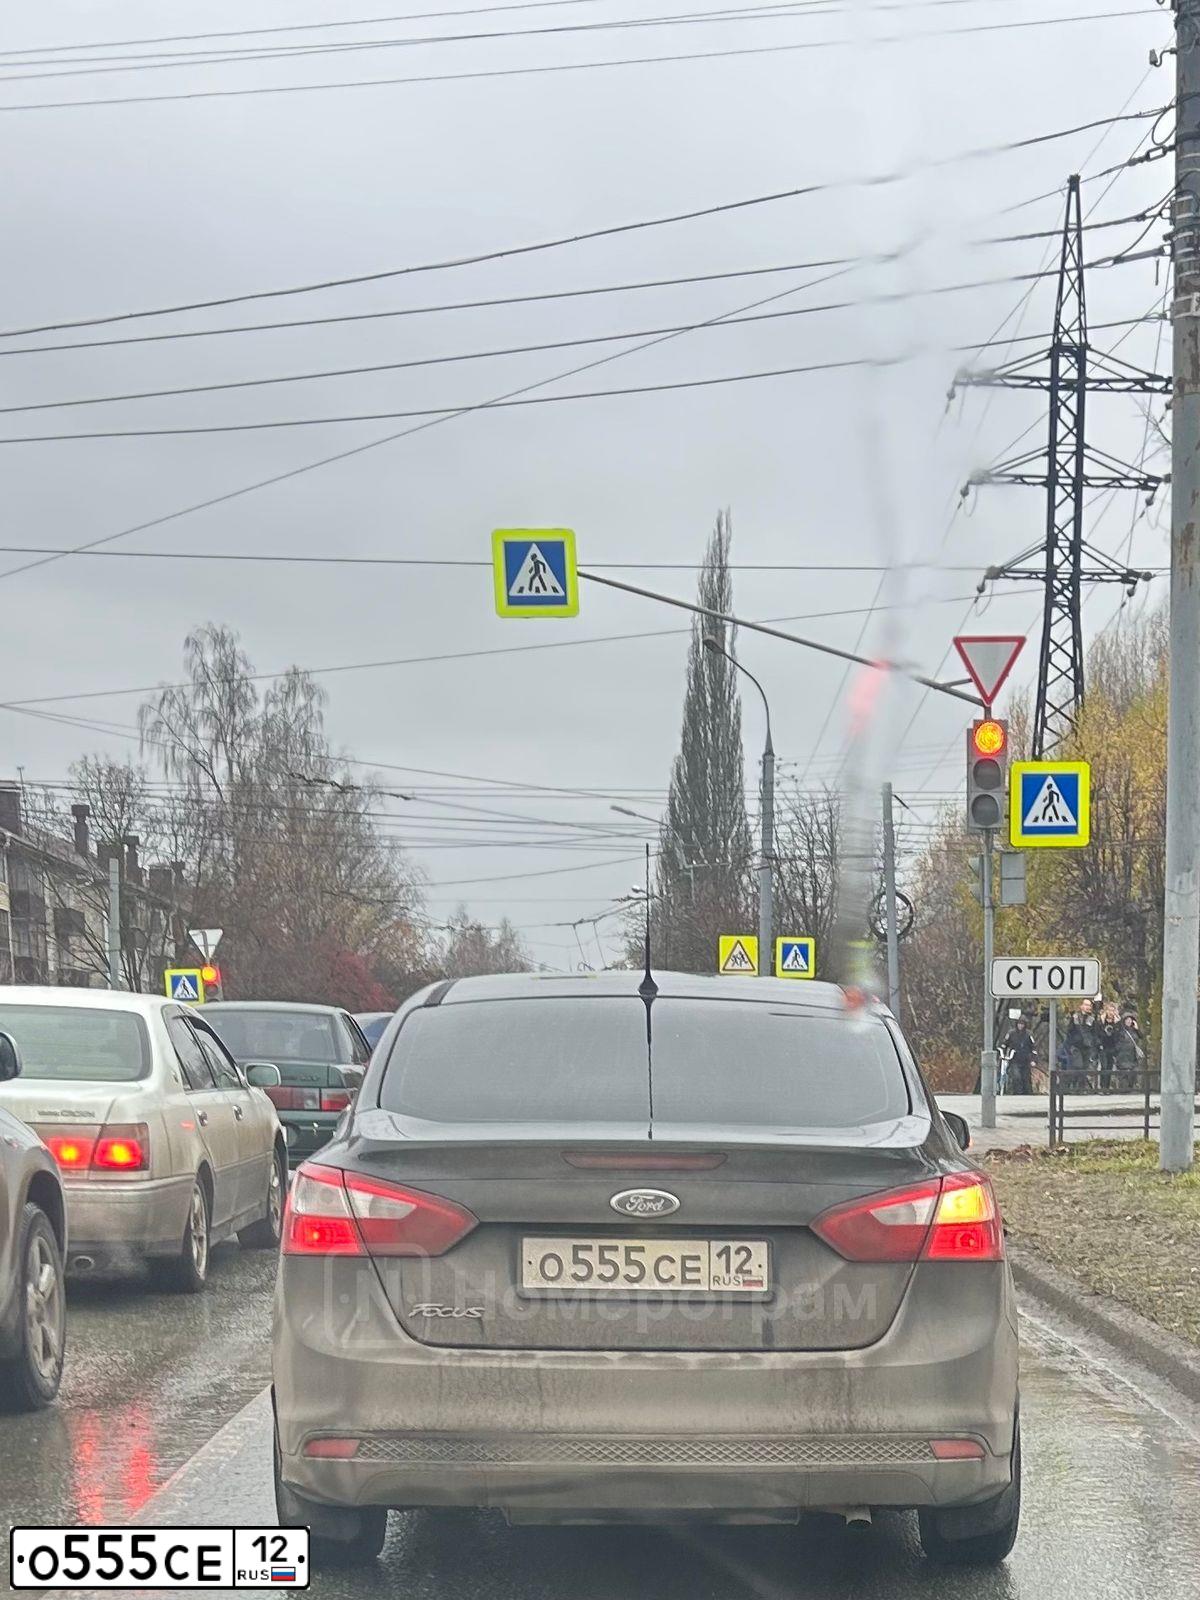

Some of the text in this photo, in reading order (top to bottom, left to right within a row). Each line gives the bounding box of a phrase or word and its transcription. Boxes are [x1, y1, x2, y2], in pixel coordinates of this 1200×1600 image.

[1006, 965, 1086, 990] СТОП
[625, 1194, 665, 1211] Ford
[539, 1244, 753, 1284] О555СЕ 12
[712, 1276, 741, 1286] RUS
